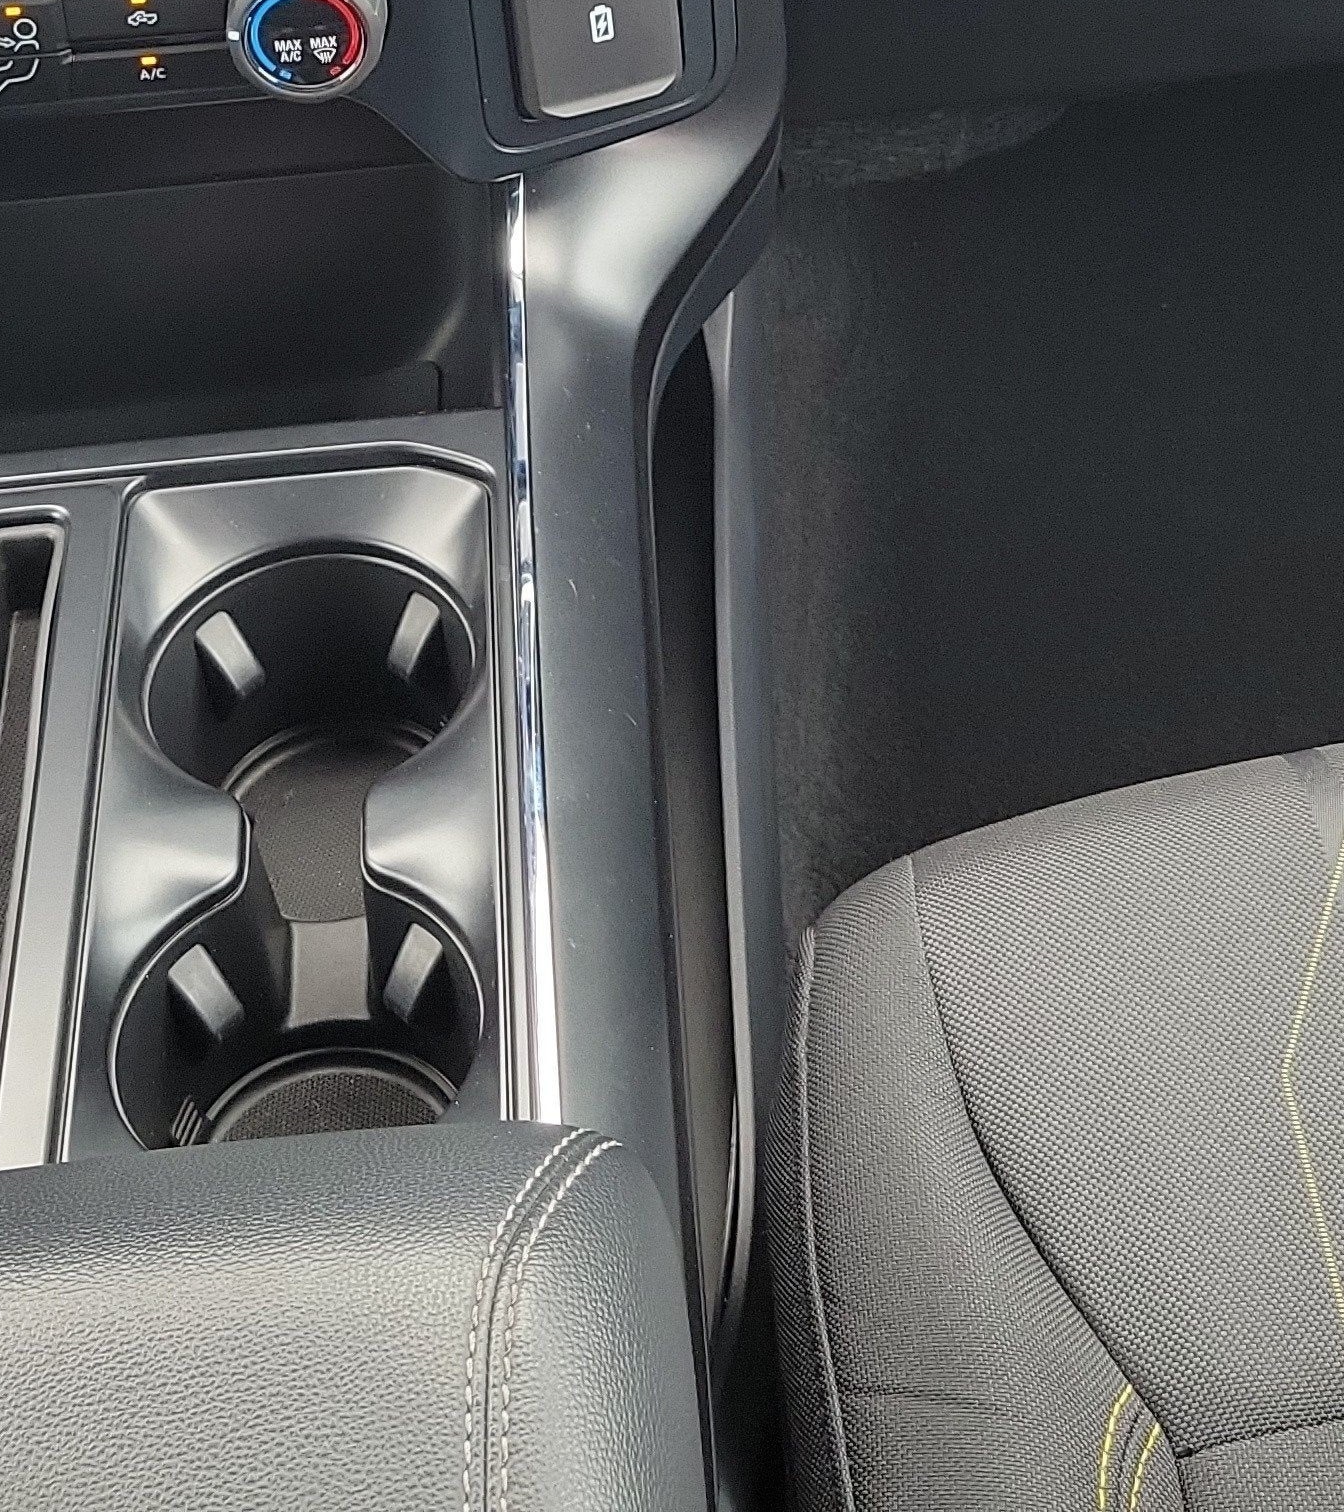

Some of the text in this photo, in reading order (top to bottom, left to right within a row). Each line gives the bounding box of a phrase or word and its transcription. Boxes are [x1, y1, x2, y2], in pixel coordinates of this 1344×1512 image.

[273, 38, 303, 54] MAX
[309, 35, 338, 50] MAX
[280, 49, 303, 64] A/C
[139, 66, 168, 82] A/C
